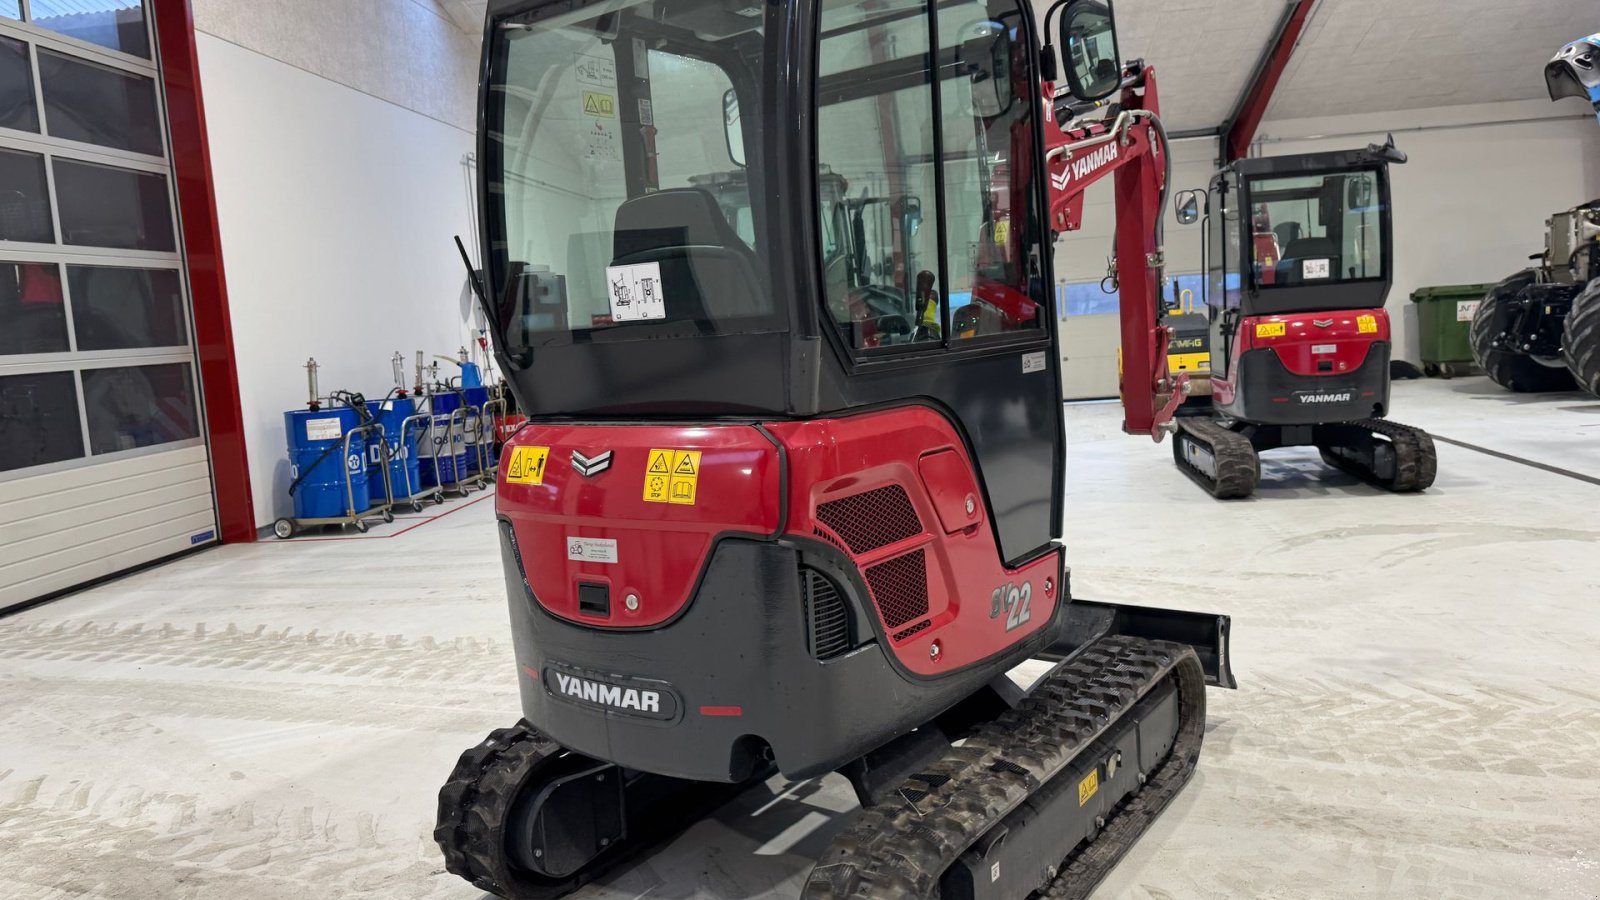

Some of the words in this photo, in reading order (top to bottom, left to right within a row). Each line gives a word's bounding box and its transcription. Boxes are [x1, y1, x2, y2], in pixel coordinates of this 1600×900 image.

[1072, 141, 1117, 181] YANMAR
[1300, 393, 1351, 403] YANMAR
[556, 672, 660, 712] YANMAR
